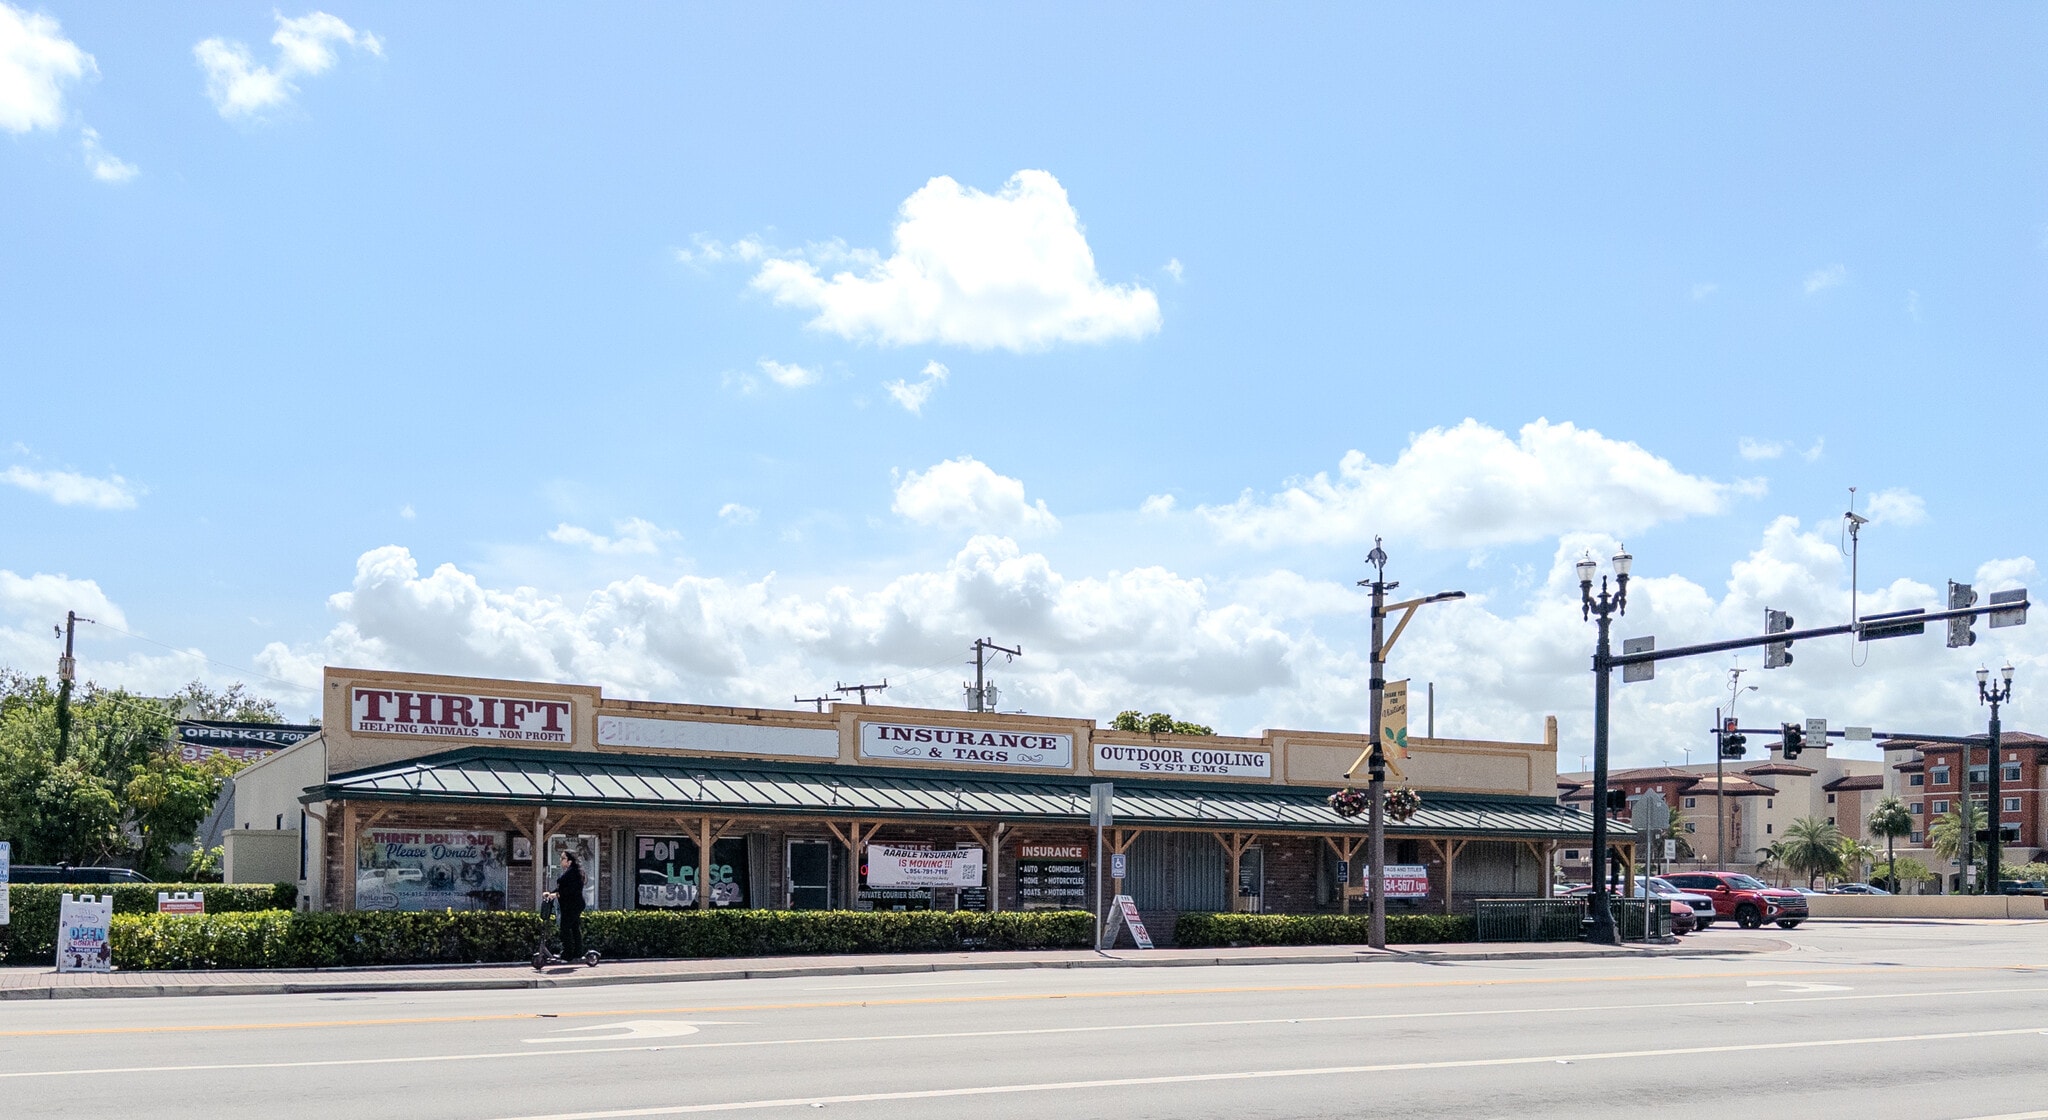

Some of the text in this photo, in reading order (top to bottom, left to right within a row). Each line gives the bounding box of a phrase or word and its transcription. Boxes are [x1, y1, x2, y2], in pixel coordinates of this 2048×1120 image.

[355, 690, 569, 731] THRIFT
[185, 728, 305, 741] OPEN K-12 FOR
[359, 722, 565, 741] HELPING ANIMALS NON PROFIT
[877, 726, 1057, 750] INSURANCE
[928, 747, 1008, 762] & TAGS
[1100, 746, 1264, 767] OUTDOOR COOLING
[1139, 762, 1229, 773] SYSTEMS
[373, 832, 494, 846] THRIFT BOUTIQUE
[386, 843, 477, 860] Please Donate
[639, 838, 679, 860] For
[920, 851, 968, 859] INSURANCE
[1022, 846, 1082, 857] INSURANCE
[898, 859, 907, 867] IS
[909, 860, 943, 868] MOVING
[1023, 865, 1080, 873] AUTO COMMERCIAL
[908, 890, 932, 899] SERVICE
[1023, 888, 1041, 896] BOATS
[70, 927, 106, 941] OPEN
